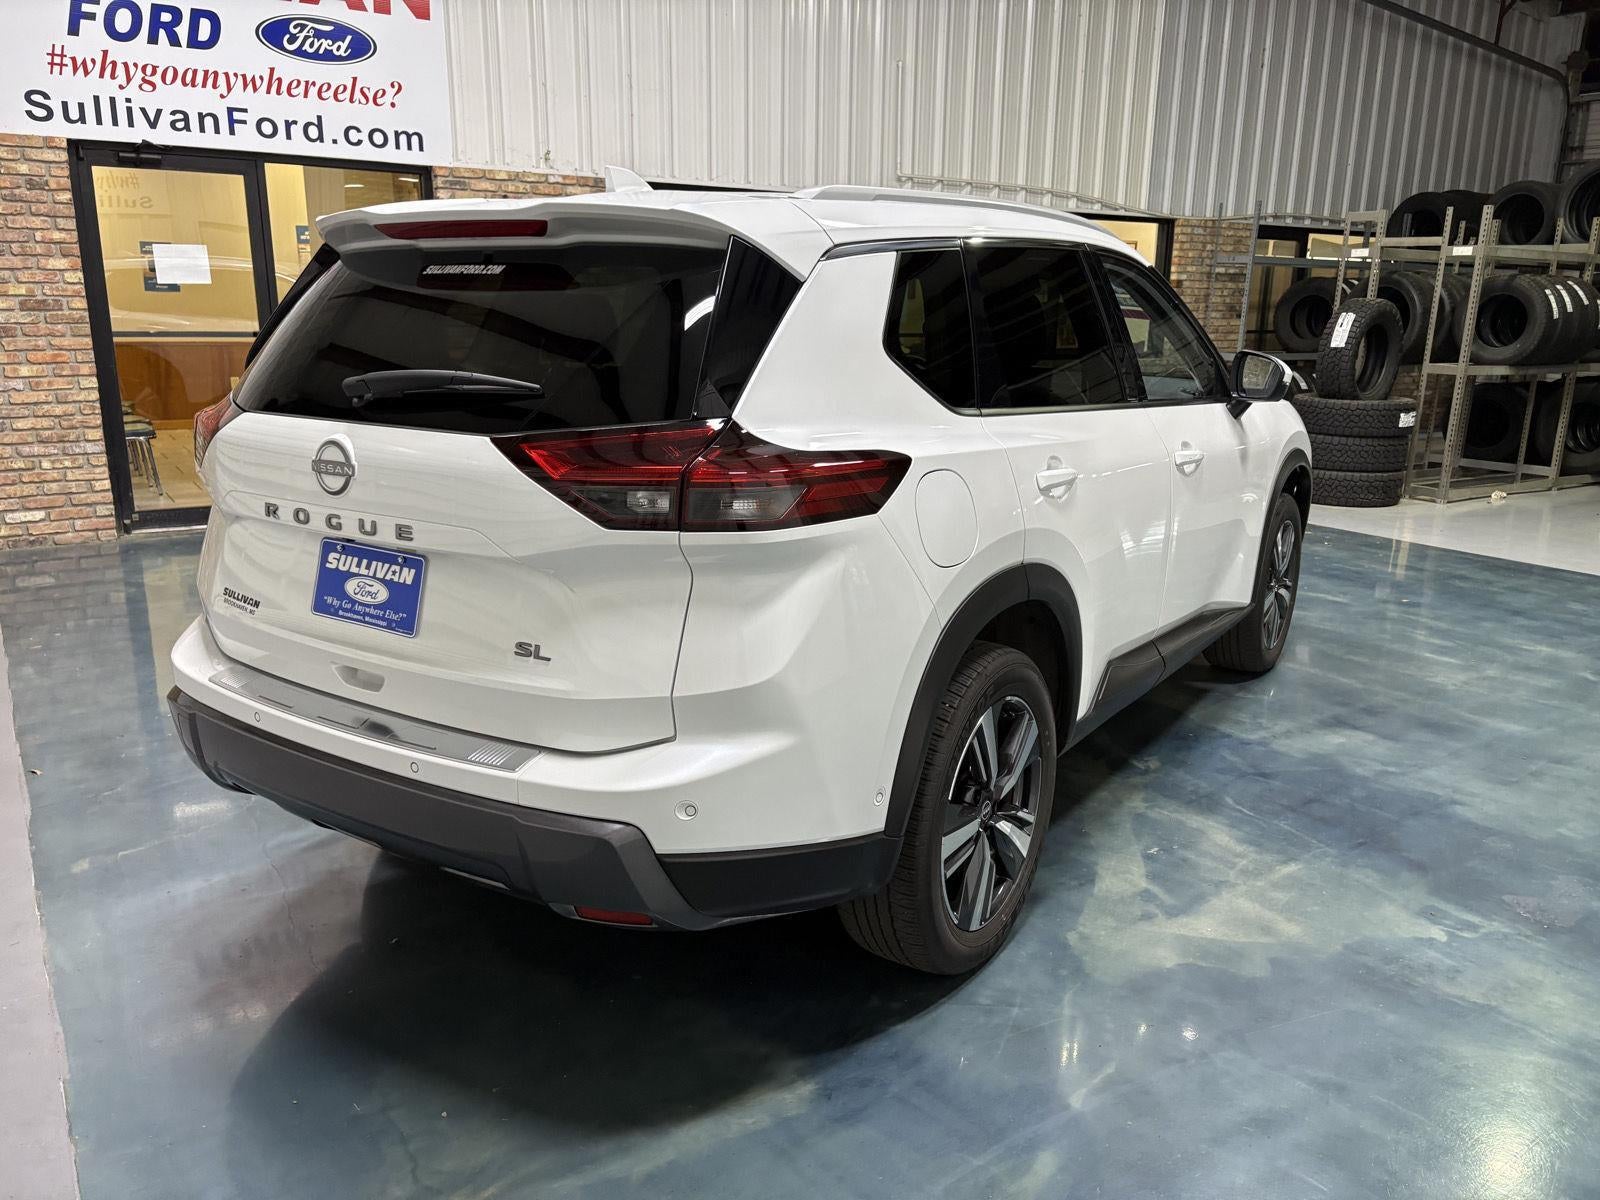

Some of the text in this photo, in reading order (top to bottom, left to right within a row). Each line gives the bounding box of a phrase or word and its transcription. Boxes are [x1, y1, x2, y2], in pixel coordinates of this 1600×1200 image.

[66, 0, 222, 51] FORD
[282, 19, 353, 57] Ford
[46, 43, 404, 109] #whygoanywhereelse?
[23, 88, 426, 153] SullivanFord.com
[264, 502, 414, 542] ROGUE
[325, 552, 415, 584] SULLIVAN
[222, 586, 261, 609] SULLIVAN
[353, 580, 379, 600] Ford
[342, 600, 352, 609] Go
[353, 603, 386, 616] Anywhere
[514, 641, 551, 661] SL
